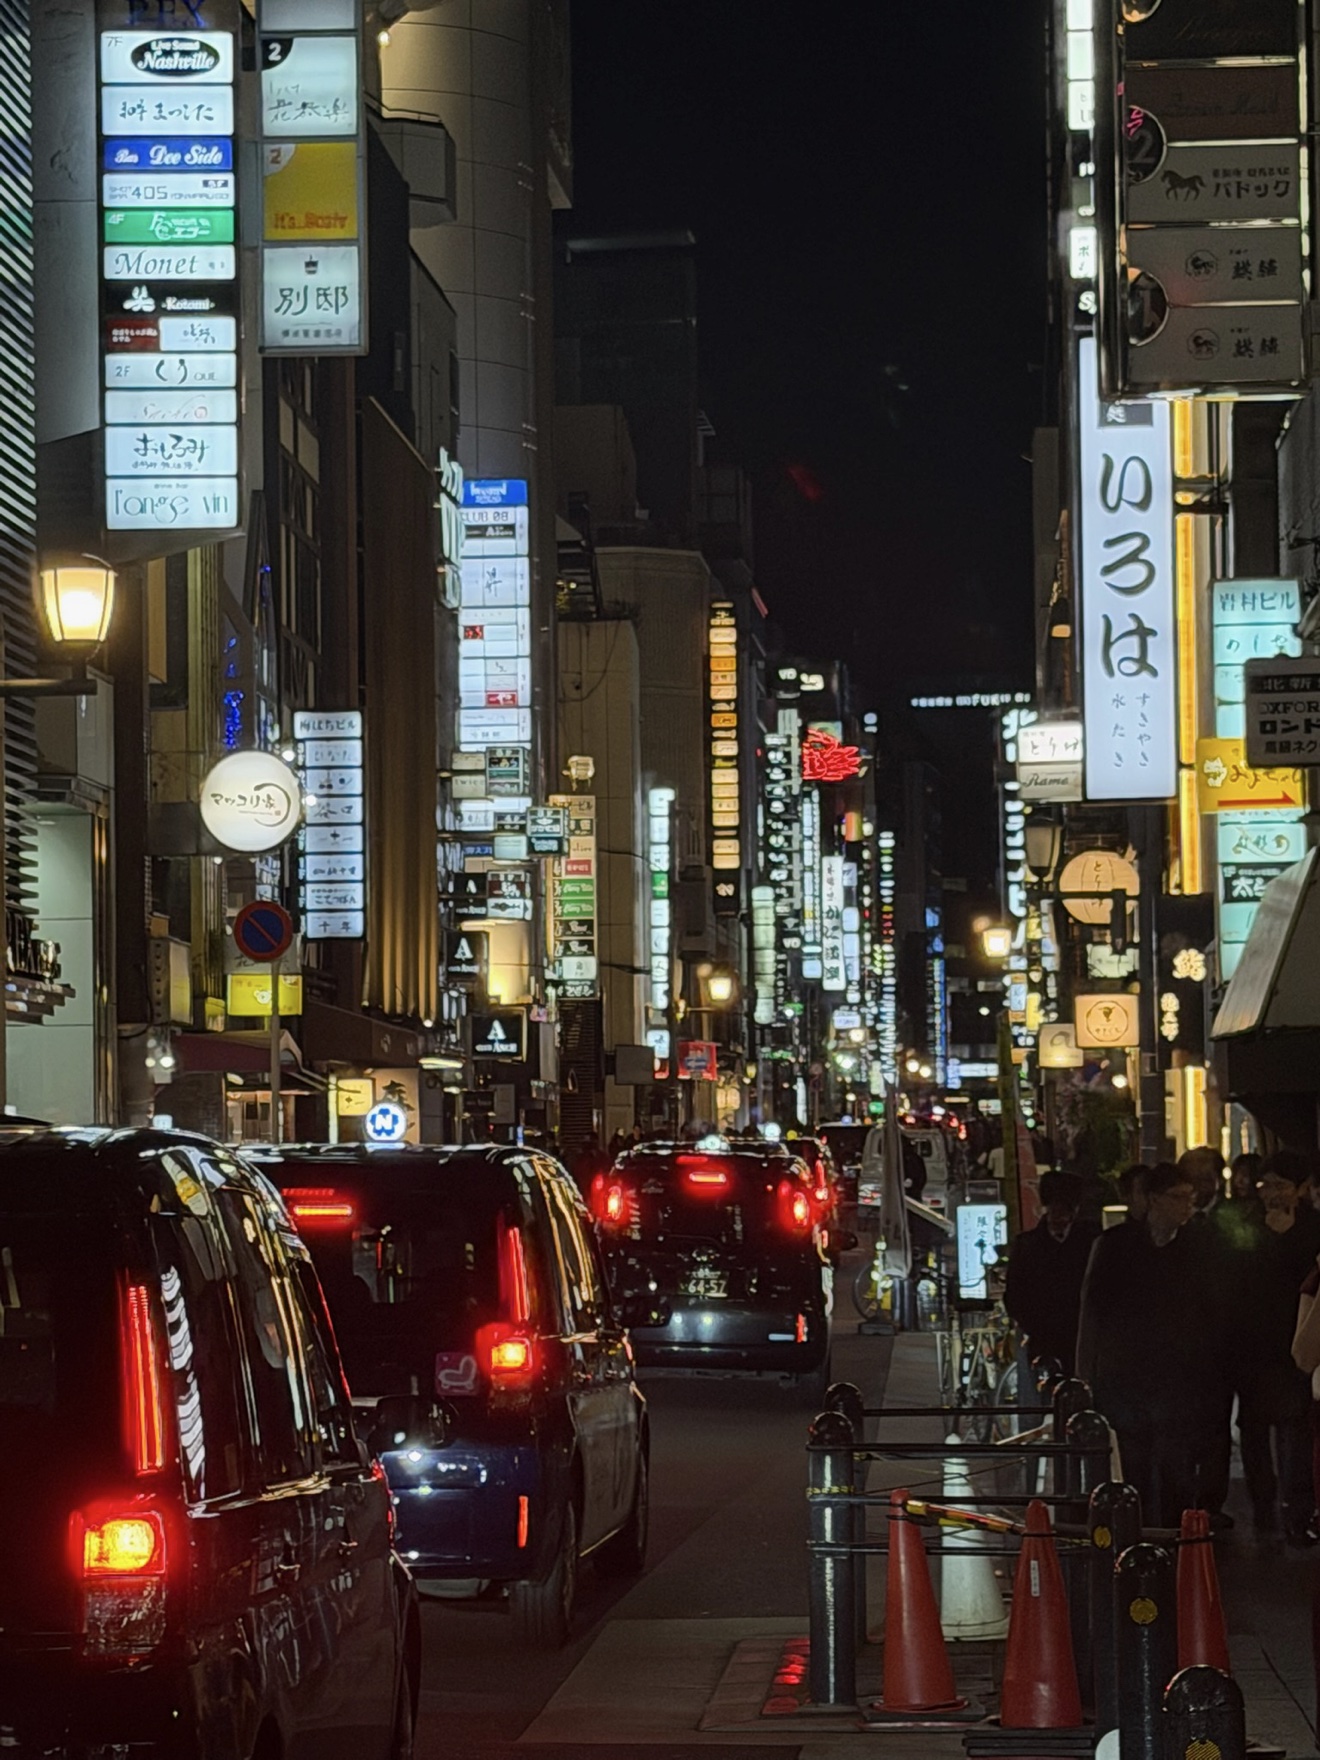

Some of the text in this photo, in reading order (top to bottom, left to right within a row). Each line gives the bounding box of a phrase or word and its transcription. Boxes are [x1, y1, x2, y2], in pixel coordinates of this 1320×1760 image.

[137, 51, 215, 70] Nashville
[268, 43, 282, 61] 2
[149, 145, 181, 165] Dee
[184, 145, 223, 165] Side
[269, 148, 282, 165] 2
[131, 186, 168, 200] 405
[115, 251, 198, 275] Monet
[274, 285, 348, 316] 別邸
[115, 366, 131, 378] 2F
[1100, 452, 1158, 679] いろは
[1262, 677, 1320, 691] 北新
[1111, 693, 1126, 768] 水たき
[1136, 692, 1151, 768] すきやき
[375, 1114, 392, 1130] N
